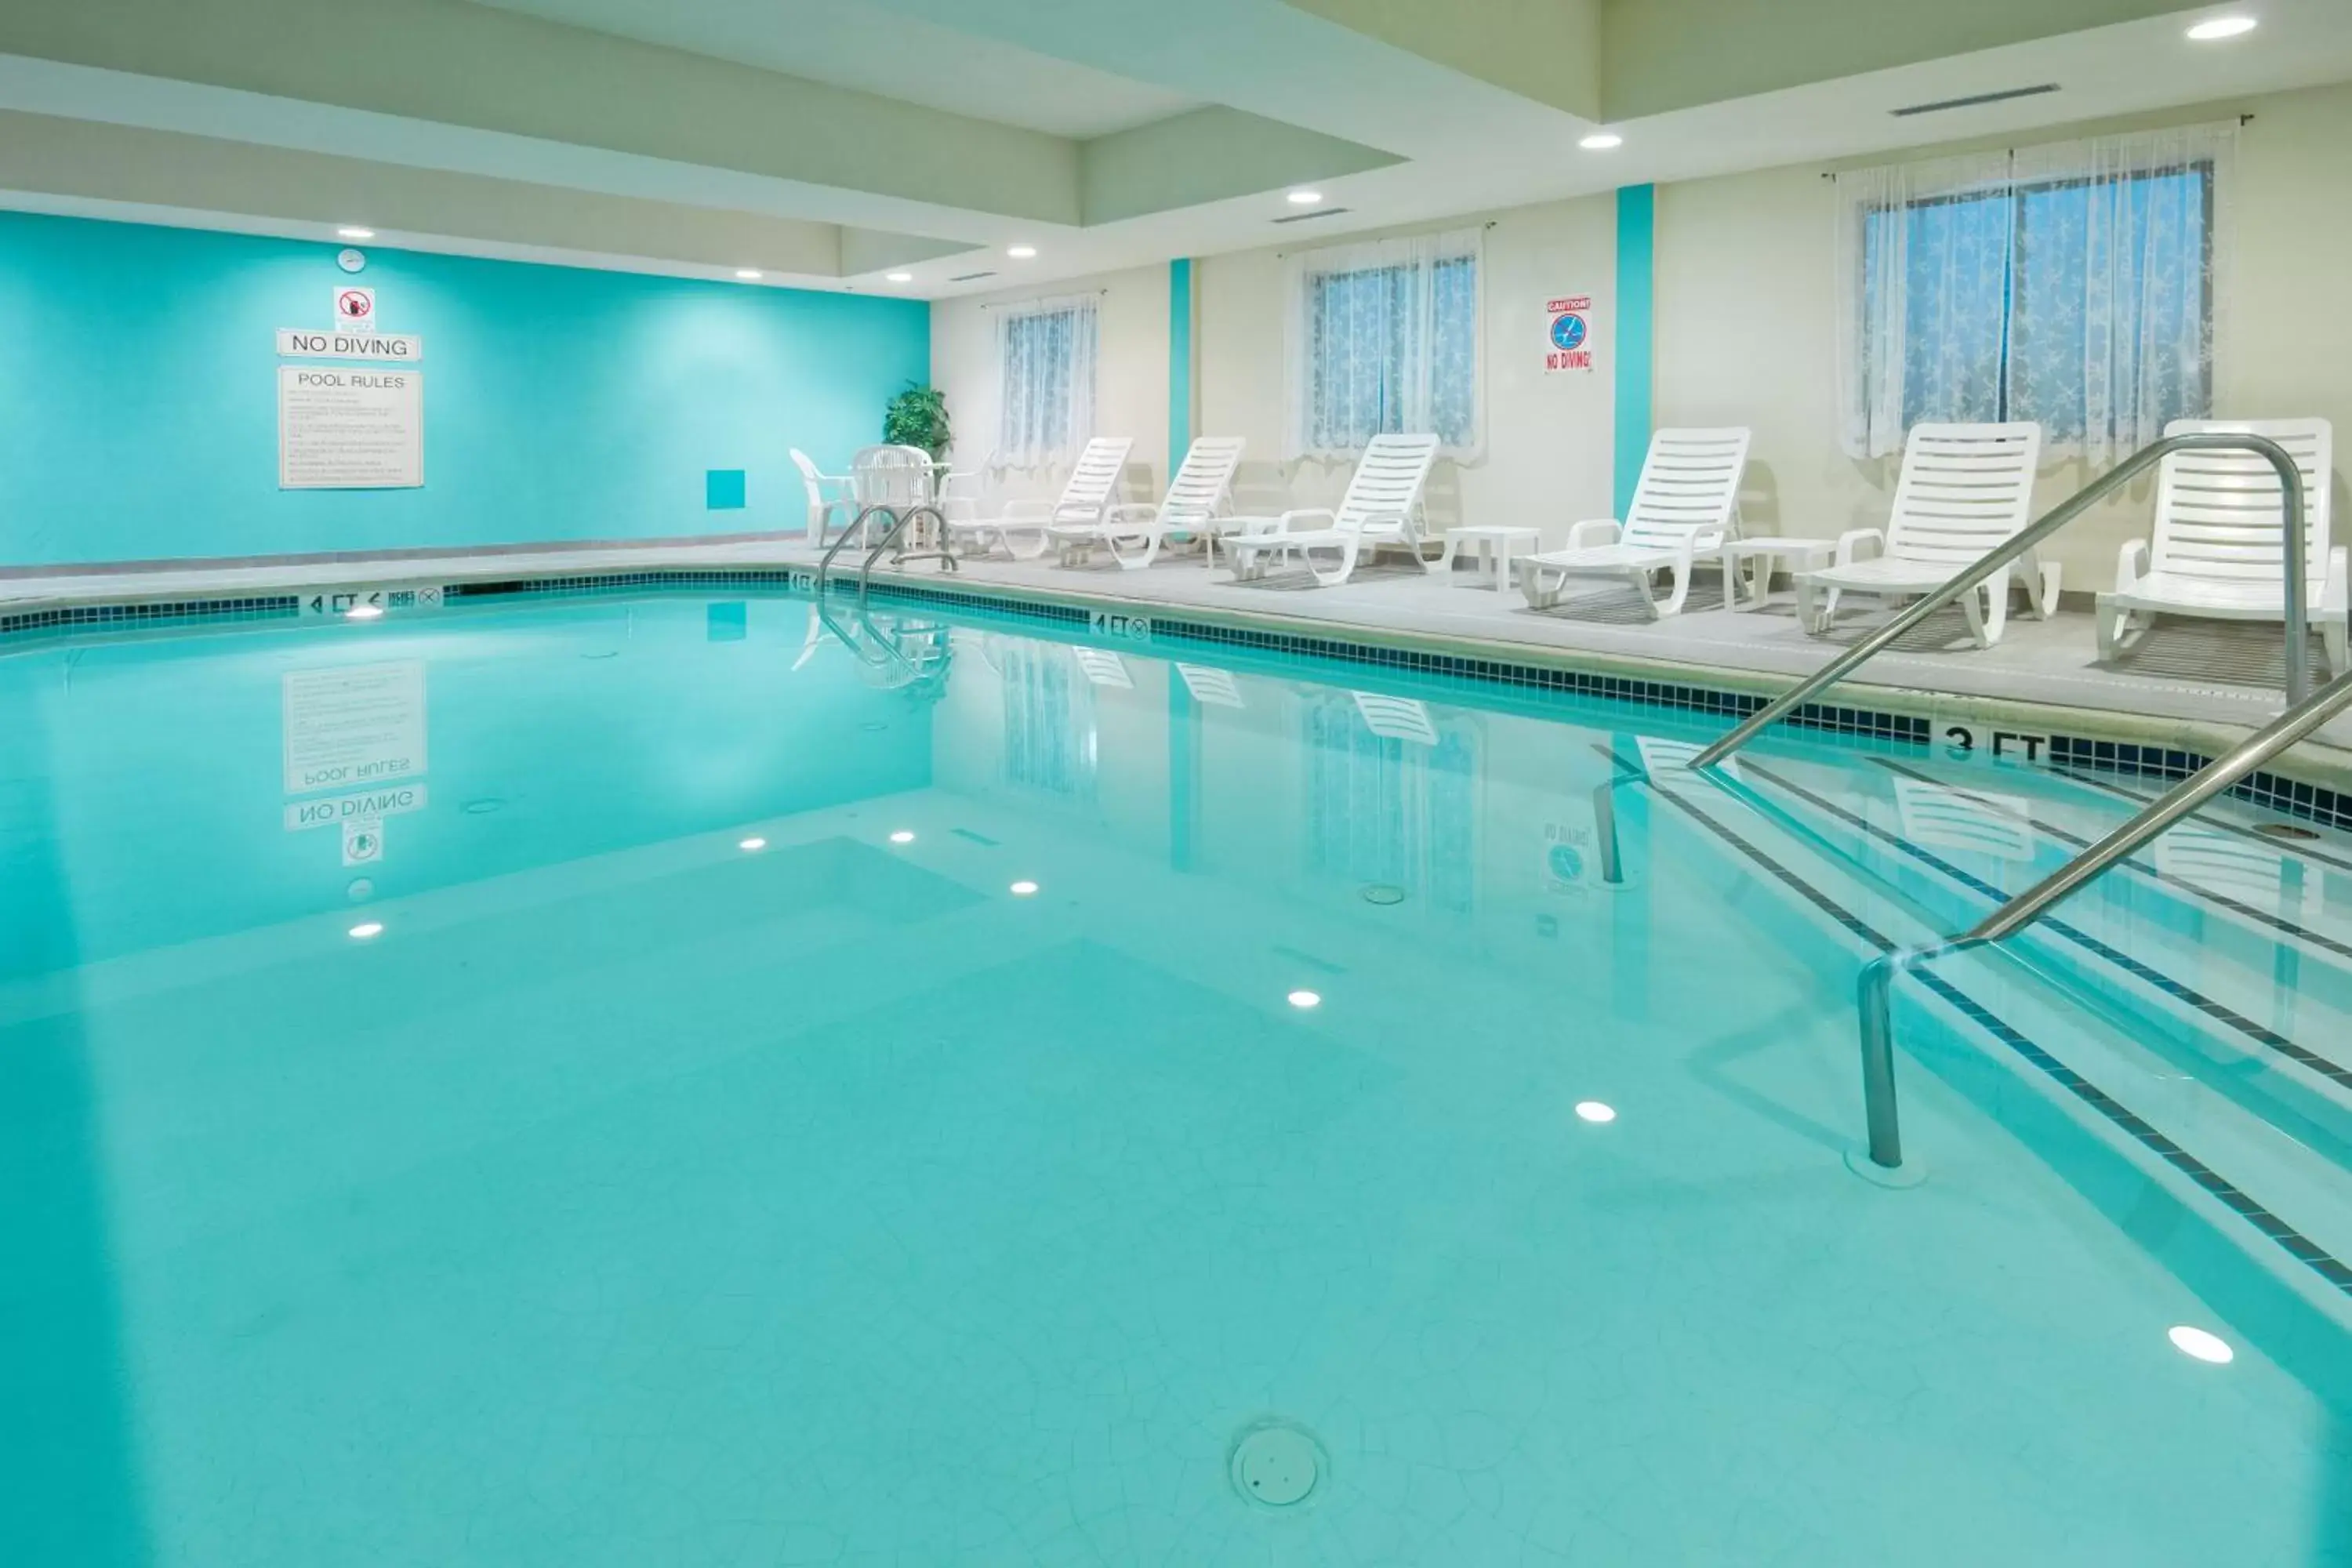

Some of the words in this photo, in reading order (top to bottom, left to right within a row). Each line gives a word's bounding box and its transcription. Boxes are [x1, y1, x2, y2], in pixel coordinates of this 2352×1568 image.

[292, 335, 327, 353] NO
[335, 337, 408, 355] DIVING
[1547, 353, 1558, 369] NO
[298, 373, 346, 387] POOL
[351, 376, 405, 389] RULES
[1993, 731, 2045, 760] FT
